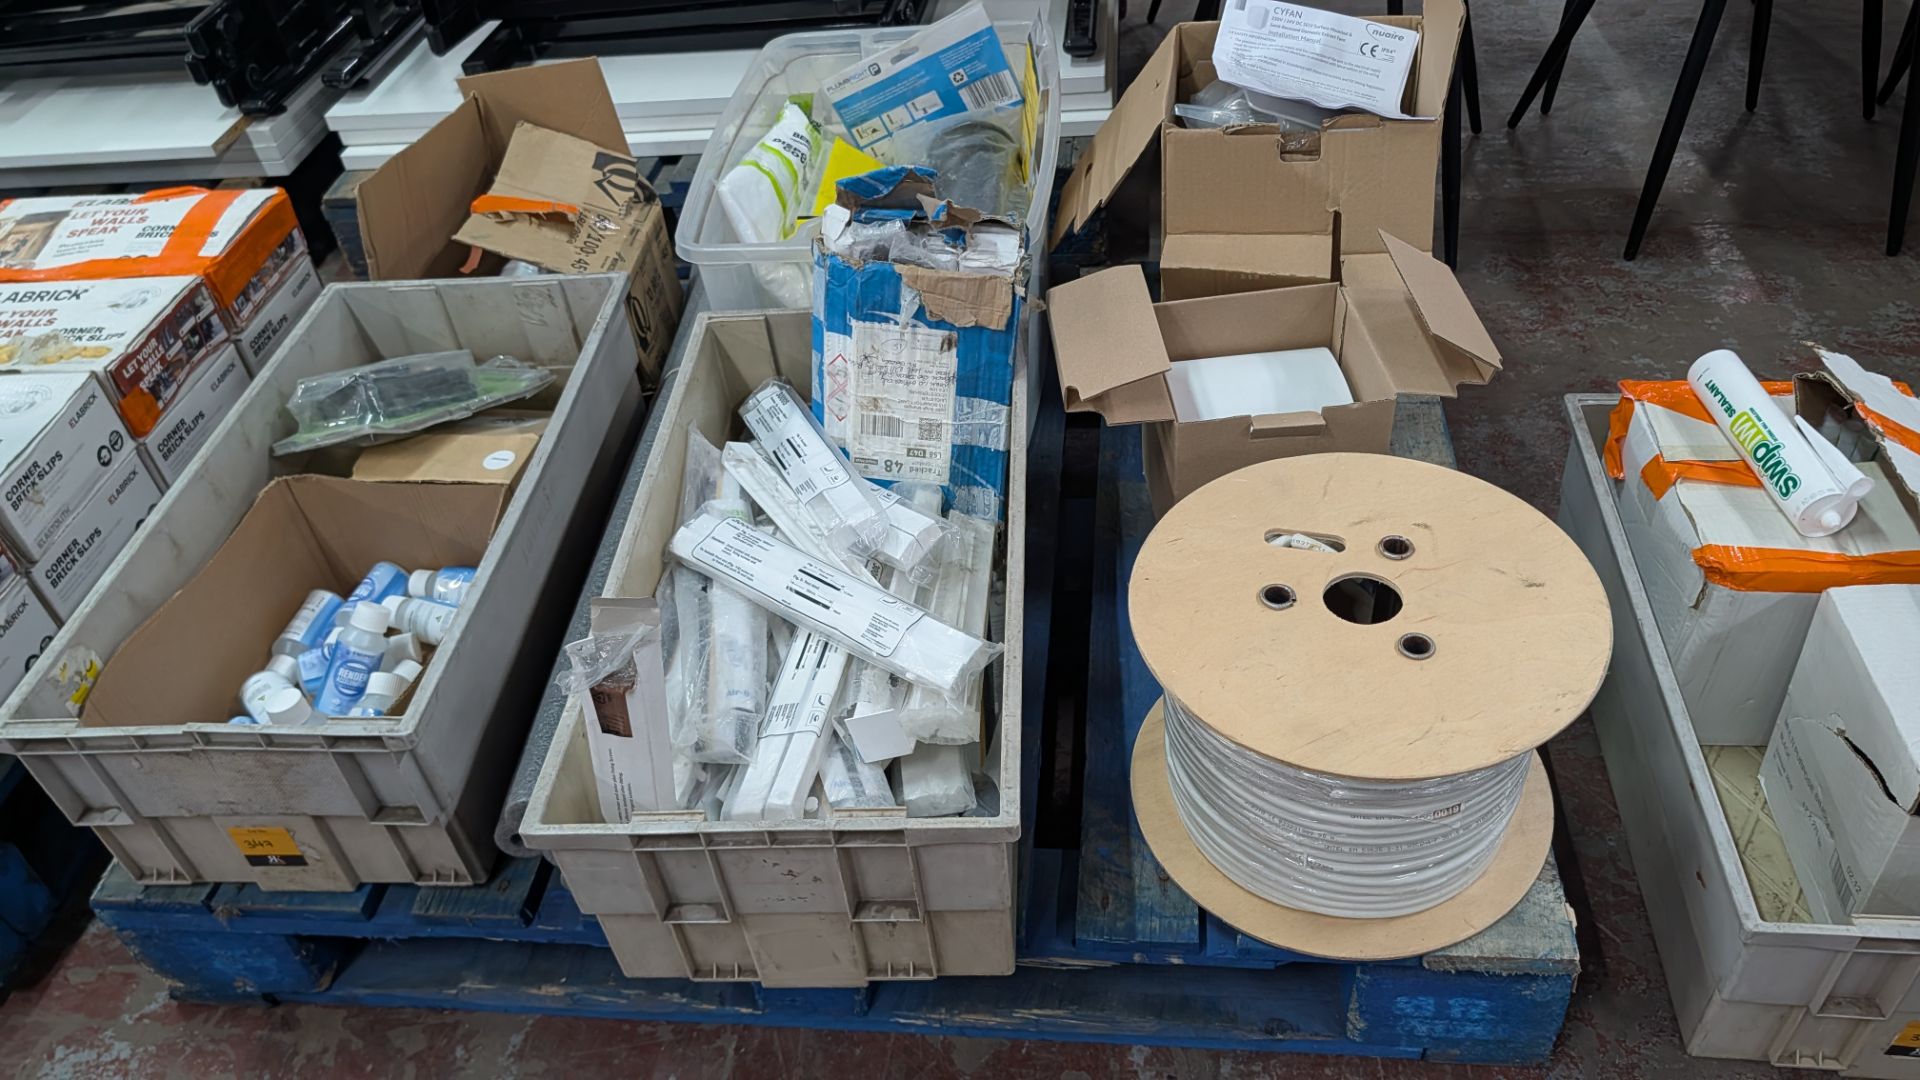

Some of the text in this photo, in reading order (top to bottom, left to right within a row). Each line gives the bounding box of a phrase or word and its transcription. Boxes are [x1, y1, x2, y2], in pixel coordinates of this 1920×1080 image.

[1273, 6, 1303, 19] CYFAN
[1268, 30, 1322, 45] Installation Manual
[1371, 26, 1406, 42] nuaire
[826, 69, 867, 94] PLUMBRIGHT
[70, 208, 149, 220] LET YOUR
[91, 216, 150, 227] WALLS
[66, 226, 121, 240] SPEAK
[9, 308, 58, 319] YOUR
[249, 319, 273, 350] CORNER
[252, 314, 288, 358] BRICK SLIPS
[122, 338, 158, 379] LET YOUR
[140, 345, 166, 375] WALLS
[139, 362, 164, 393] SPEAK
[67, 391, 99, 430] ELABRICK
[1703, 378, 1736, 418] SEALANT
[157, 418, 187, 452] CORNER
[161, 409, 206, 462] BRICK SLIPS
[4, 459, 41, 502] CORNER
[10, 450, 64, 513] BRICK SLIPS
[884, 459, 904, 474] 48
[909, 466, 943, 477] Tracked
[107, 466, 140, 506] ELABRICK
[44, 537, 80, 581] CORNER
[49, 526, 103, 590] BRICK SLIPS
[243, 839, 274, 850] 347
